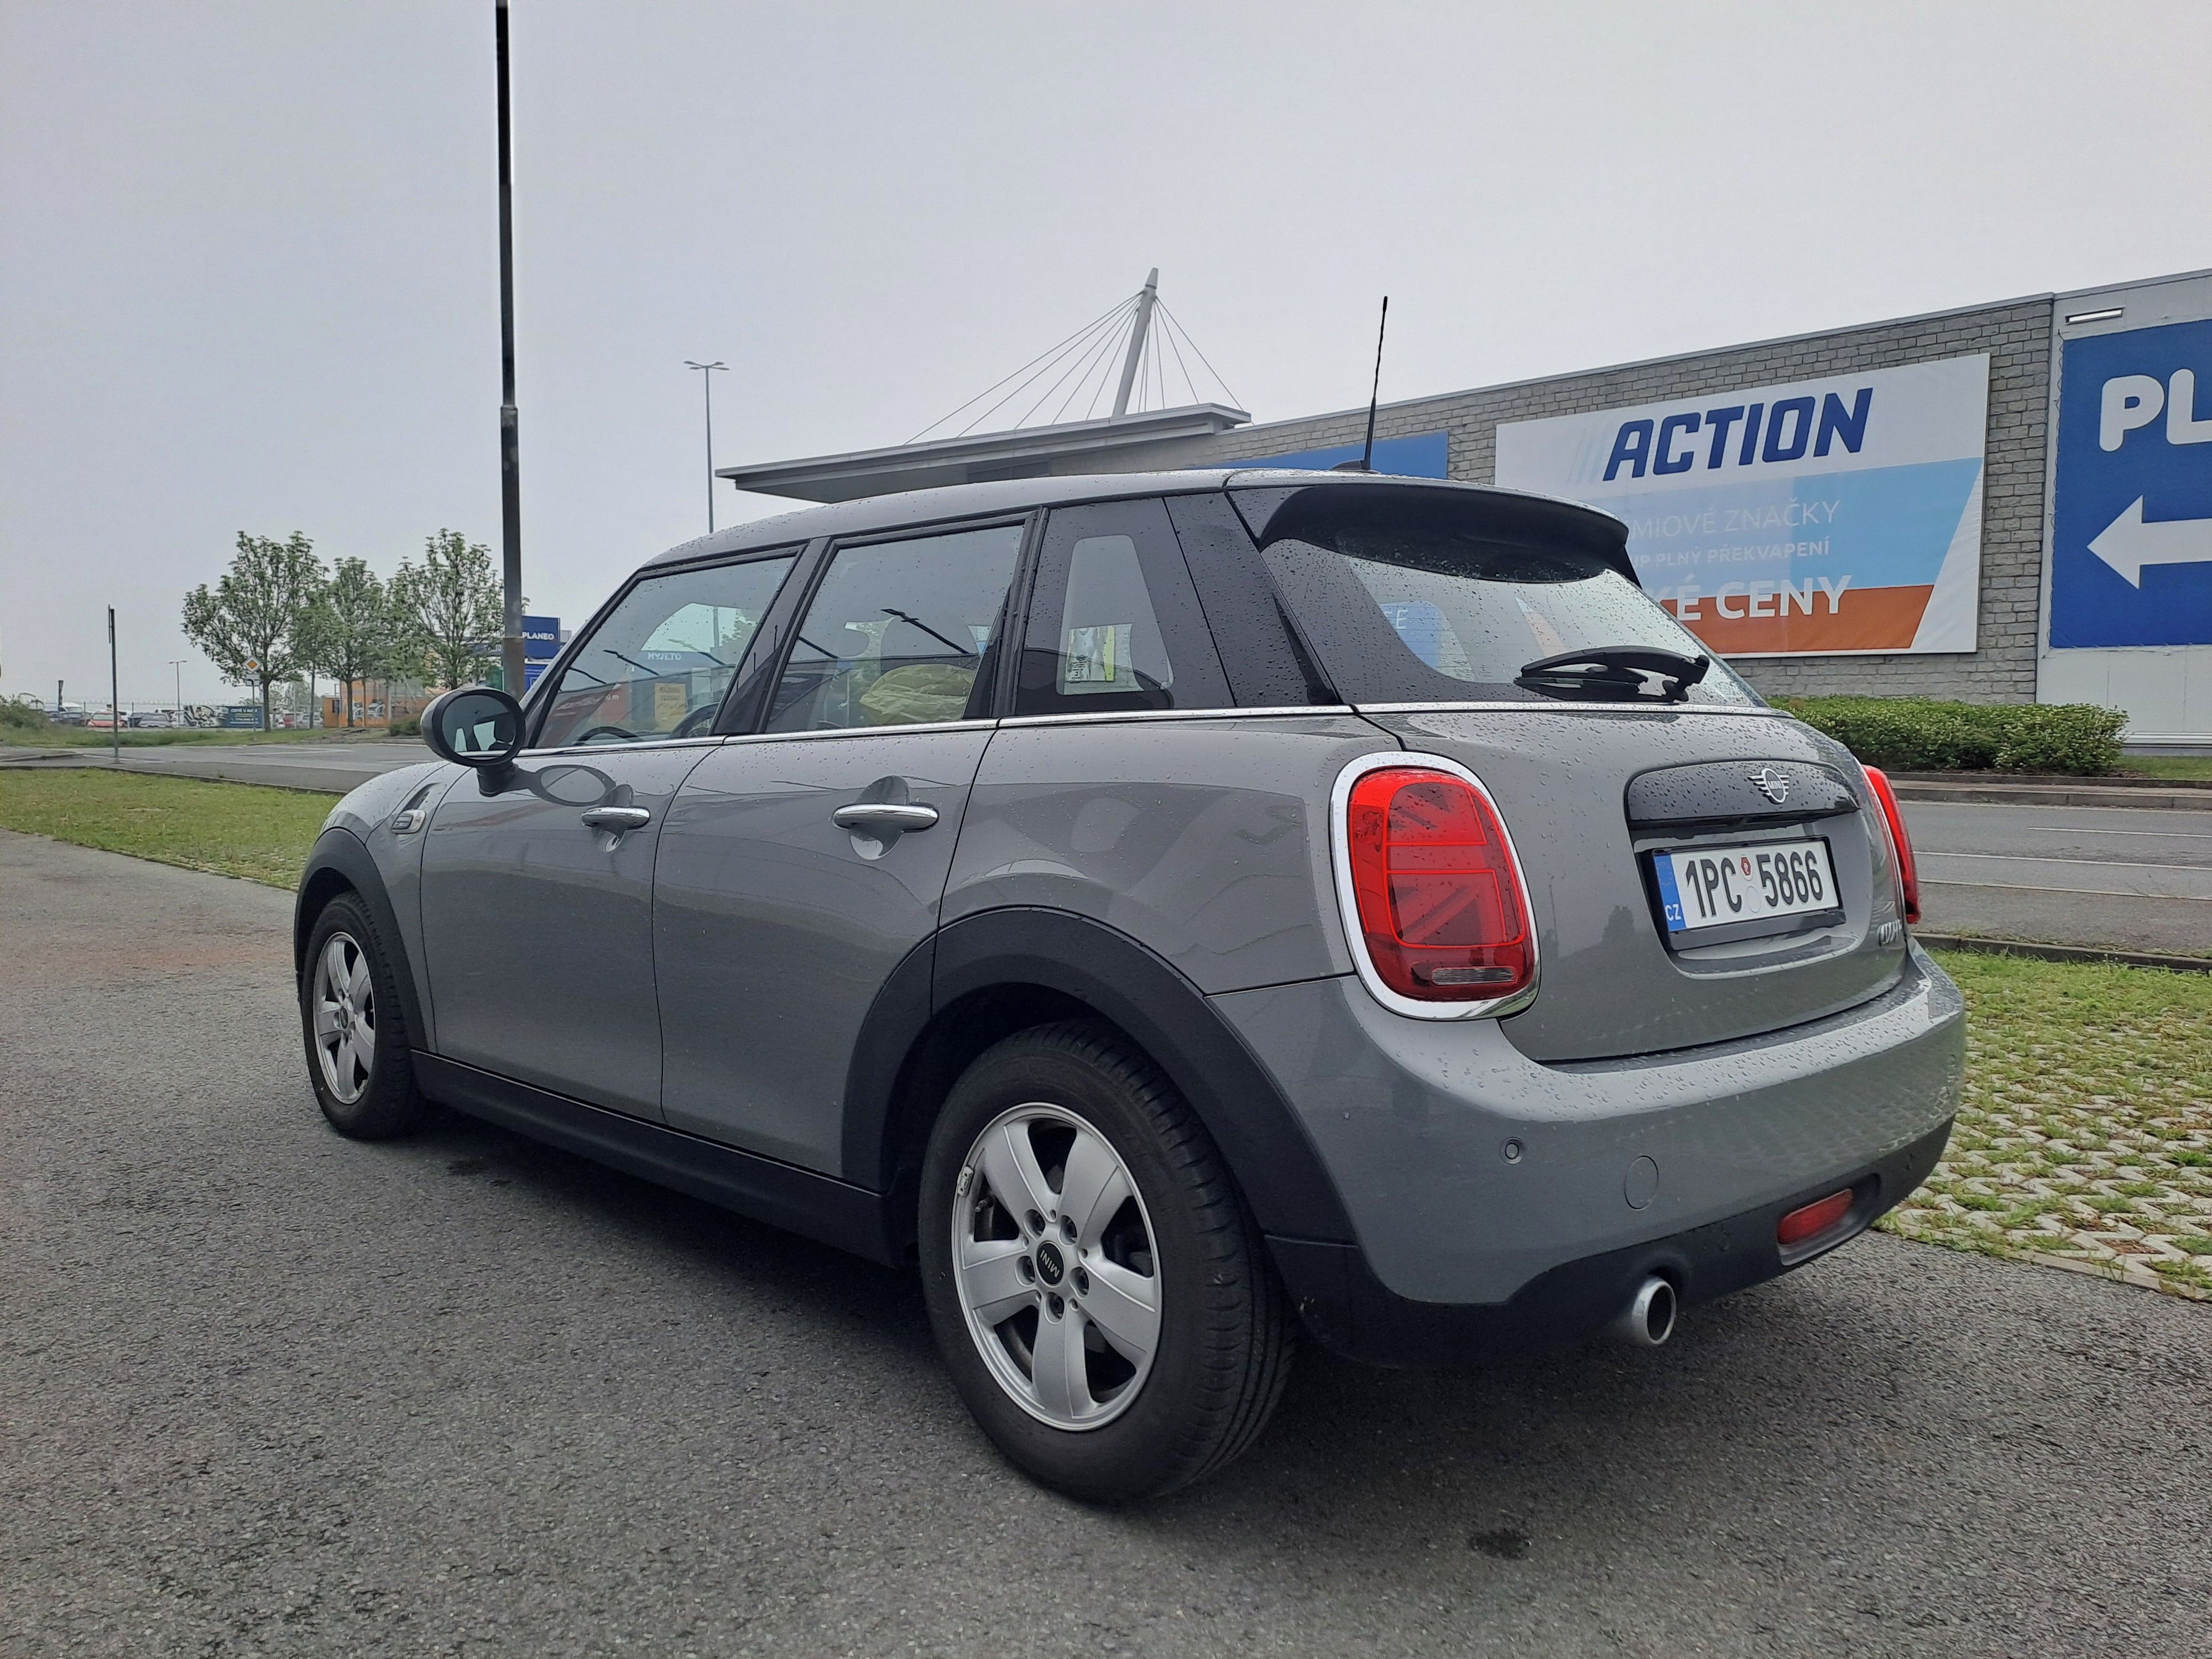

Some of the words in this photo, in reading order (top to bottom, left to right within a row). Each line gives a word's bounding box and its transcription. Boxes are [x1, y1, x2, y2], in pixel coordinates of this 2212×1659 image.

[2099, 368, 2212, 452] PL
[1603, 387, 1873, 482] ACTION
[1723, 497, 1840, 533] ZNAČKY
[1656, 546, 1702, 566] PLNÝ
[1707, 535, 1830, 563] PŘEKVAPENÍ
[1715, 575, 1852, 620] CENY
[522, 632, 555, 640] PLANEO
[1767, 780, 1783, 789] MINI
[1685, 858, 1742, 919] 1PC
[1756, 850, 1824, 908] 5866
[1665, 903, 1682, 922] CZ
[1040, 1250, 1060, 1278] MINI
